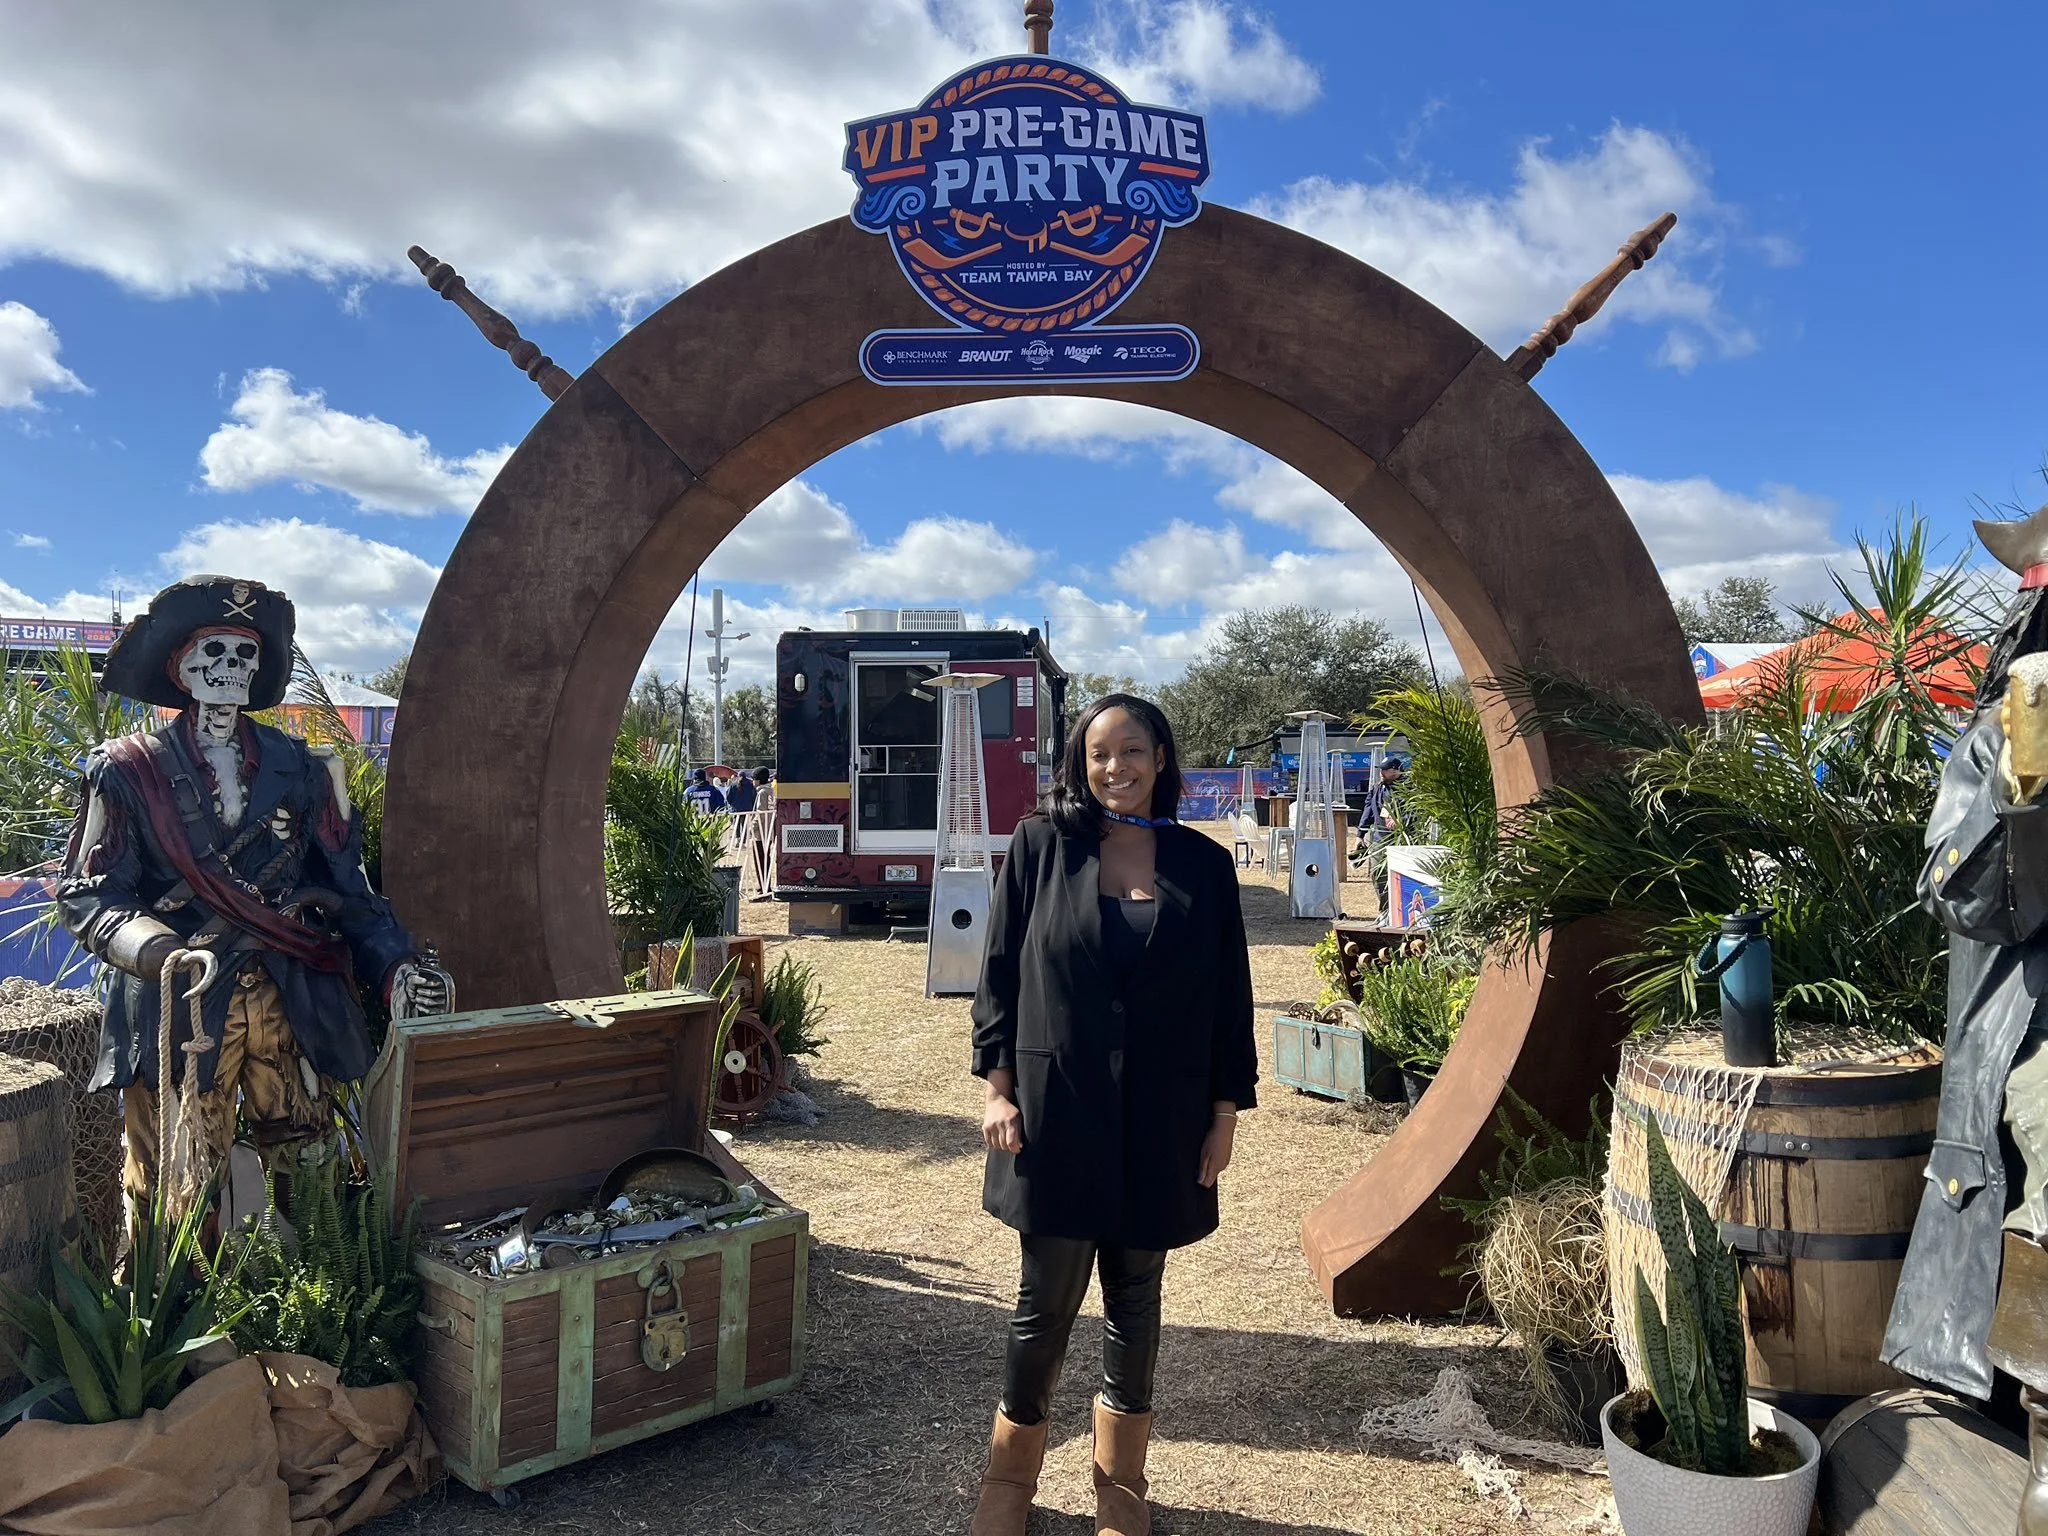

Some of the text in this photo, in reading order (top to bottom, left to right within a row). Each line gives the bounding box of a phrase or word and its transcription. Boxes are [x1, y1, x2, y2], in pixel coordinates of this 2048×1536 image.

[854, 106, 1200, 169] VIP PRE-GAME
[931, 153, 1130, 208] PARTY
[960, 270, 1093, 284] TEAM TAMPA BAY
[897, 351, 948, 359] BENCHMARK
[1020, 347, 1054, 357] Hard Rock
[1064, 345, 1102, 356] Mosaic
[1130, 346, 1167, 354] TECO
[958, 350, 1013, 362] BRANDT
